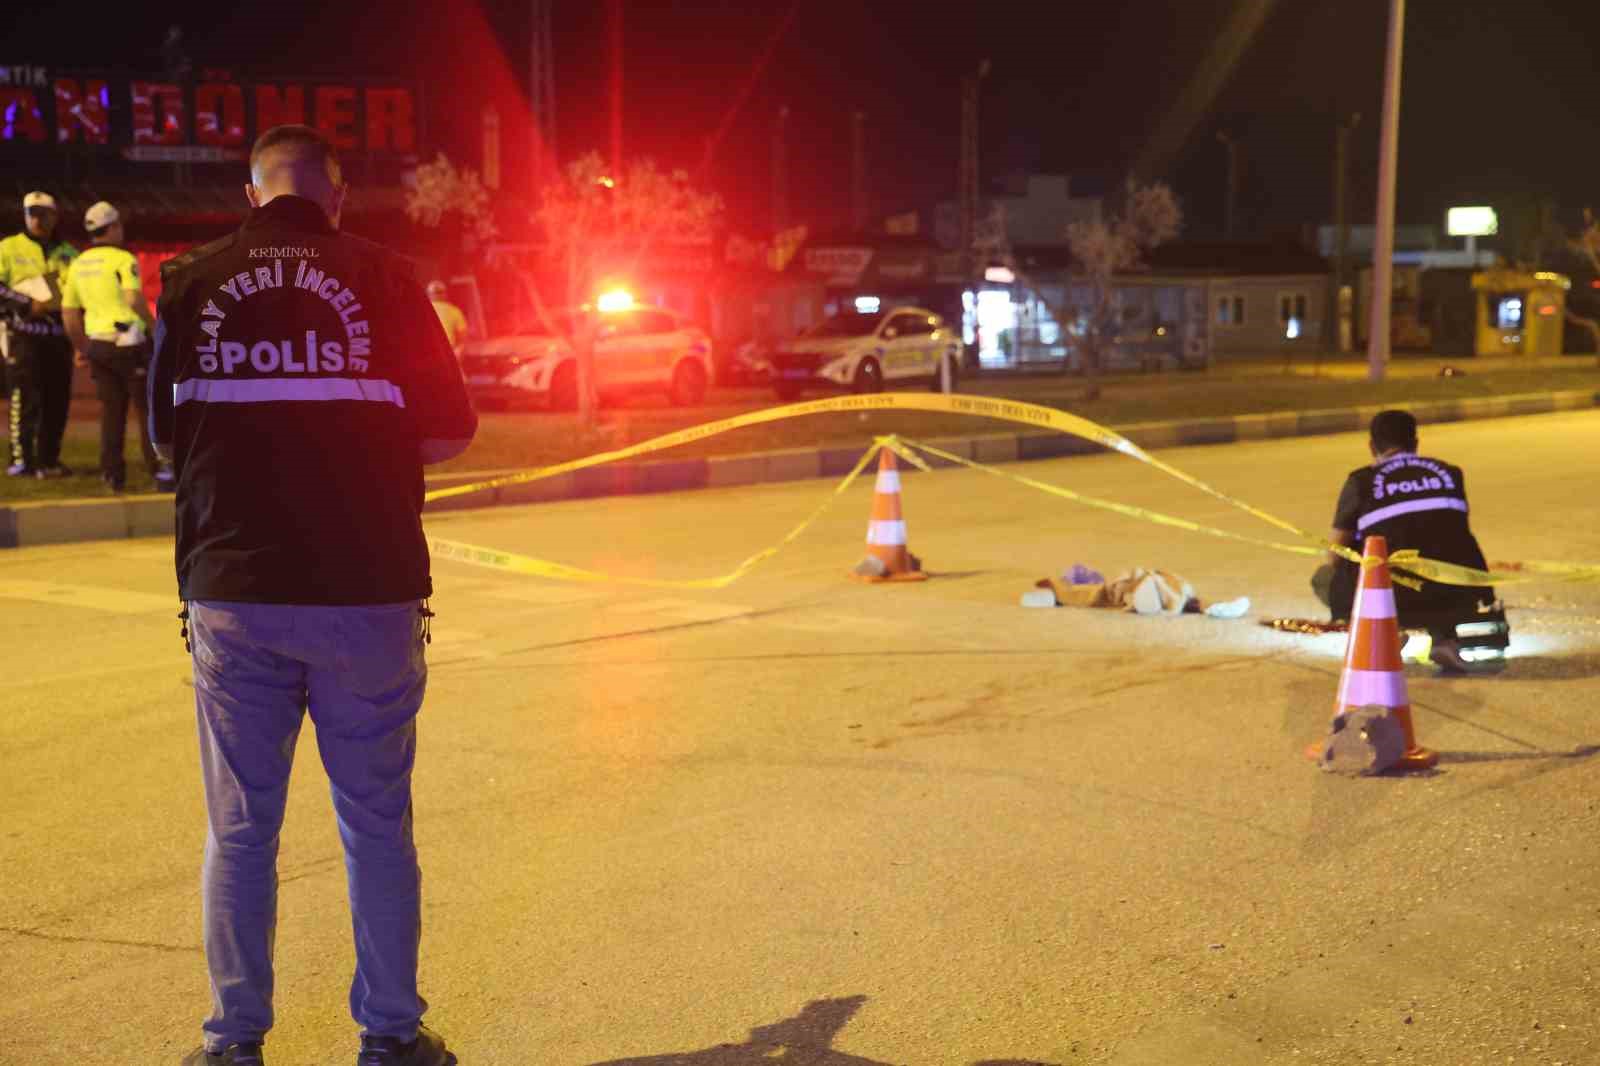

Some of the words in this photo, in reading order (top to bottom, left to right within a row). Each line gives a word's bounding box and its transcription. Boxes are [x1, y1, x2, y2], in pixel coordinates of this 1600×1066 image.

[131, 69, 414, 150] DÖNER
[248, 245, 320, 258] KRİMİNAL
[196, 299, 226, 373] OLAY
[219, 259, 283, 302] YERİ
[294, 260, 372, 373] İNCELEME
[220, 330, 345, 374] POLİS
[1386, 477, 1442, 496] POLİS
